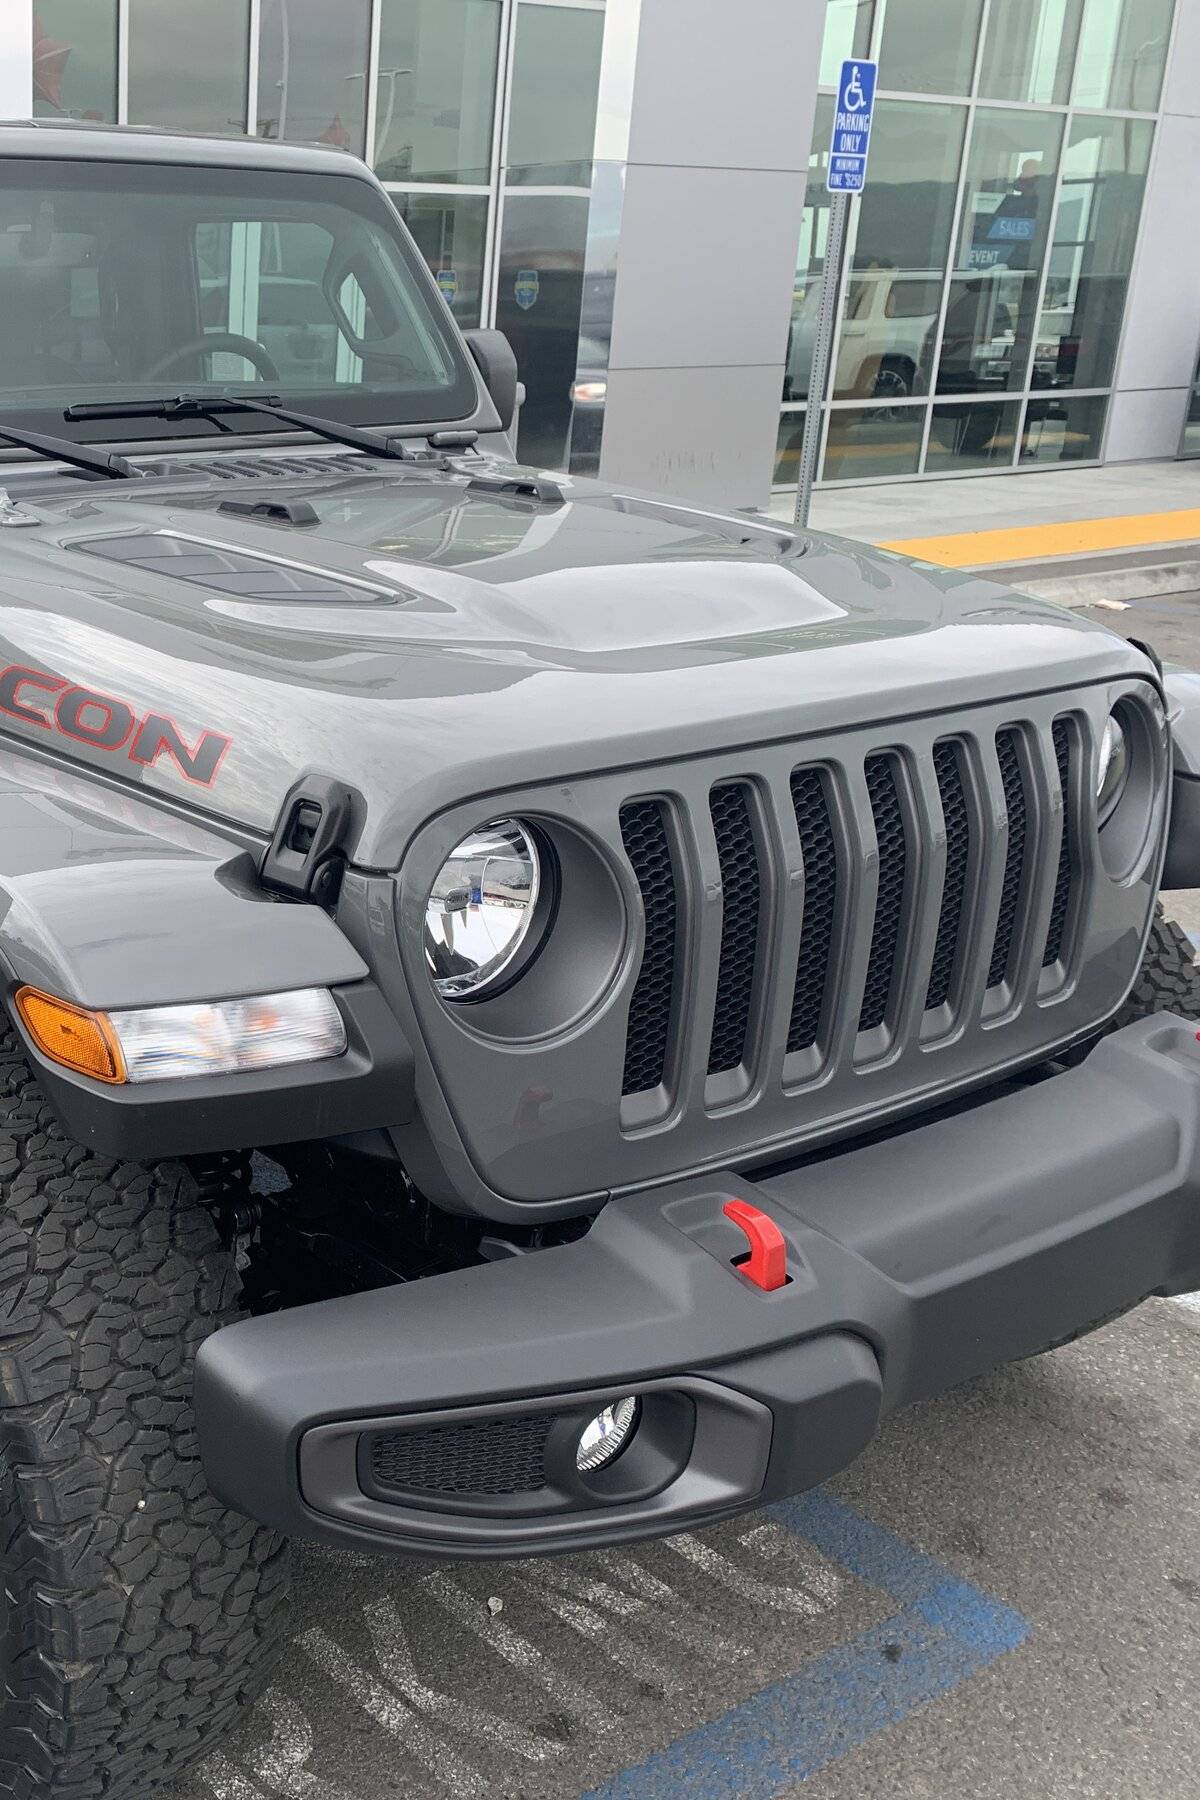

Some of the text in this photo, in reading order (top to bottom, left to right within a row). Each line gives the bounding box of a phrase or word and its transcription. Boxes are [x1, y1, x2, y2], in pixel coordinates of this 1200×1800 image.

[836, 112, 870, 132] PARKING
[840, 133, 862, 152] ONLY
[967, 249, 1000, 264] EVENT
